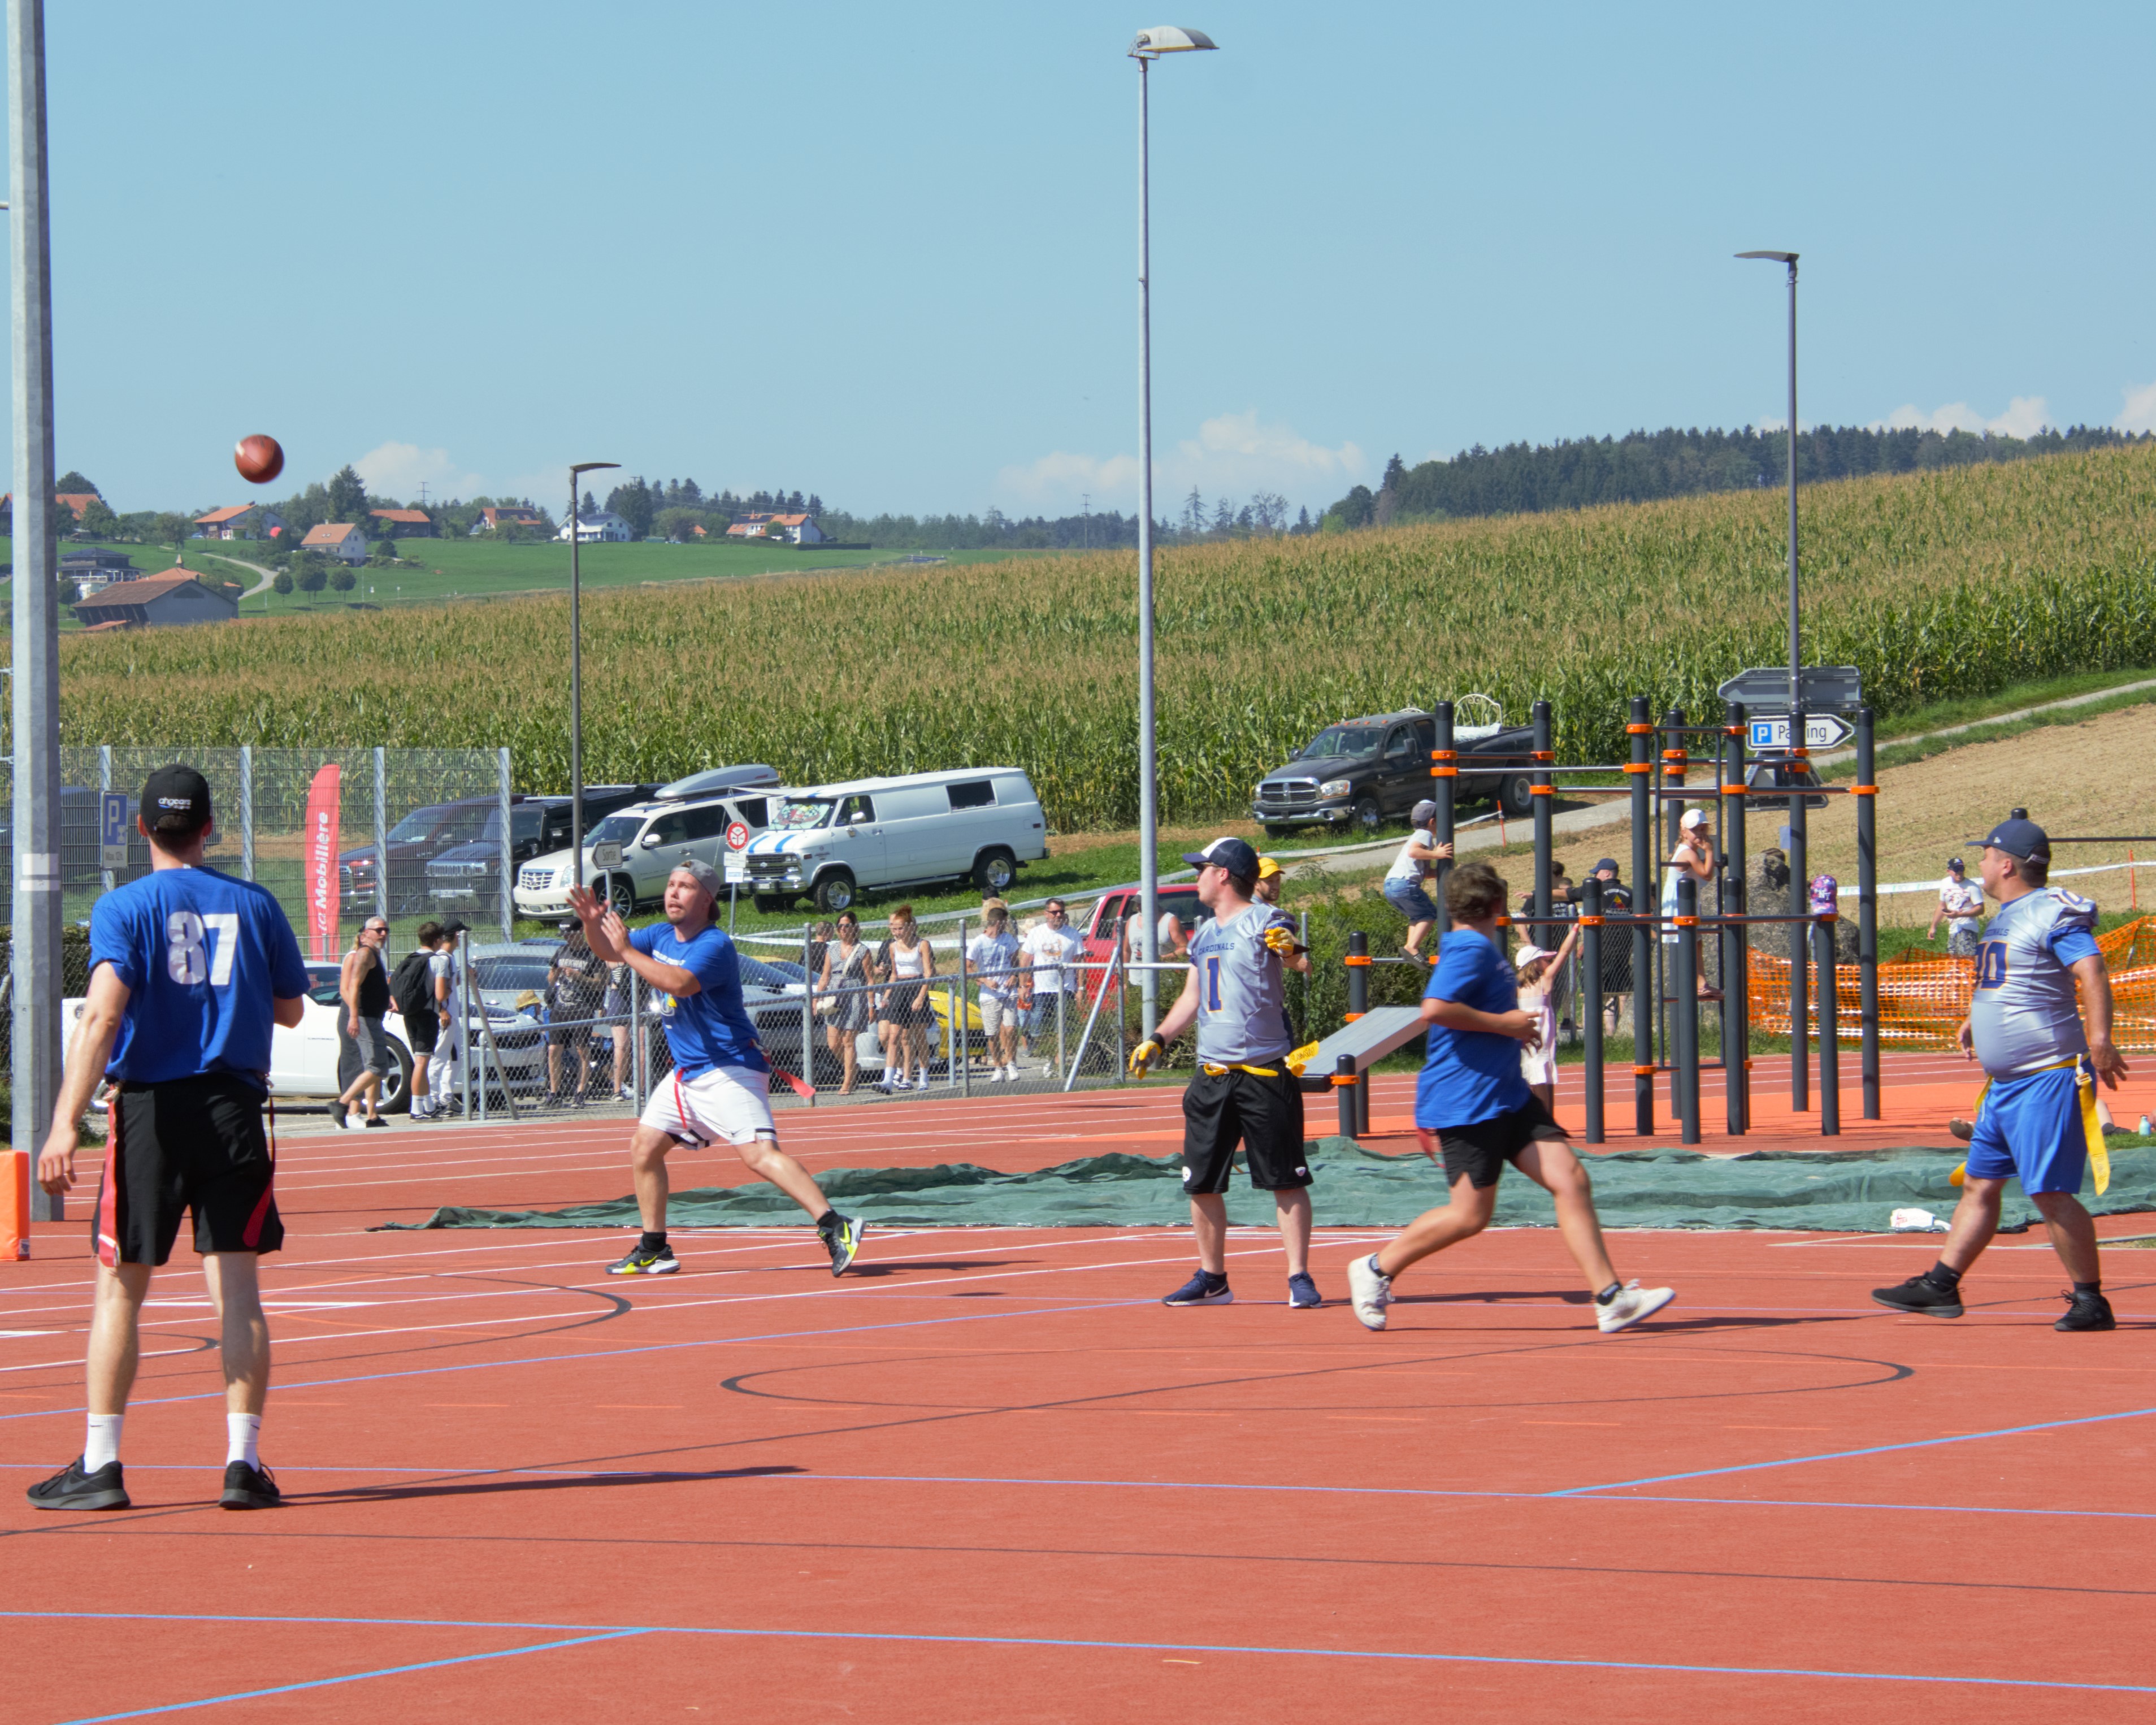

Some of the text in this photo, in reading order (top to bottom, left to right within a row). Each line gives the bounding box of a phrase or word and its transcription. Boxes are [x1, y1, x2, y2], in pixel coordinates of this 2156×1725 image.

[1758, 725, 1827, 742] P Paing
[108, 800, 119, 837] P
[315, 812, 329, 909] Mobilière
[167, 911, 238, 985] 87
[1198, 942, 1235, 956] CARDINALS
[1207, 956, 1224, 1012] 1
